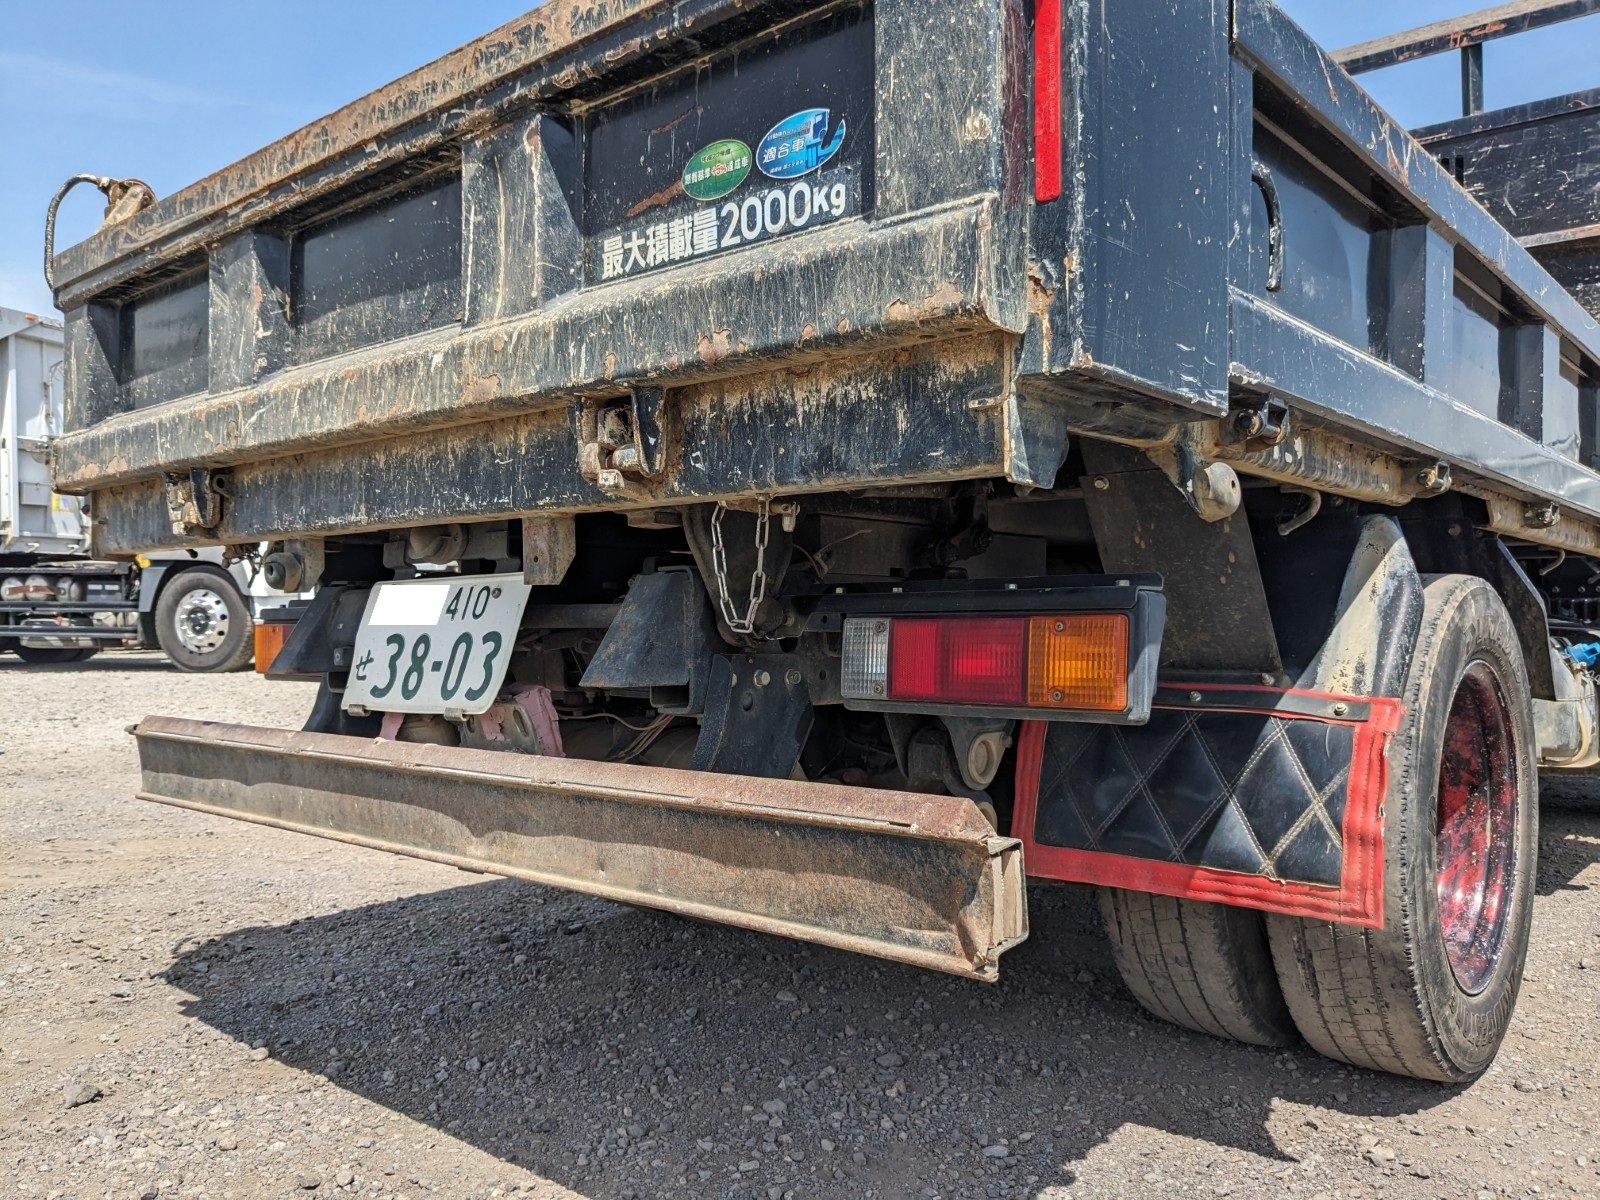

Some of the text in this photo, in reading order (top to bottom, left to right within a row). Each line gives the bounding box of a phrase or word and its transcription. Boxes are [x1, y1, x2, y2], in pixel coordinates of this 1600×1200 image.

[762, 137, 805, 164] 適合車
[446, 585, 491, 621] 410
[356, 631, 502, 701] せ 38-03
